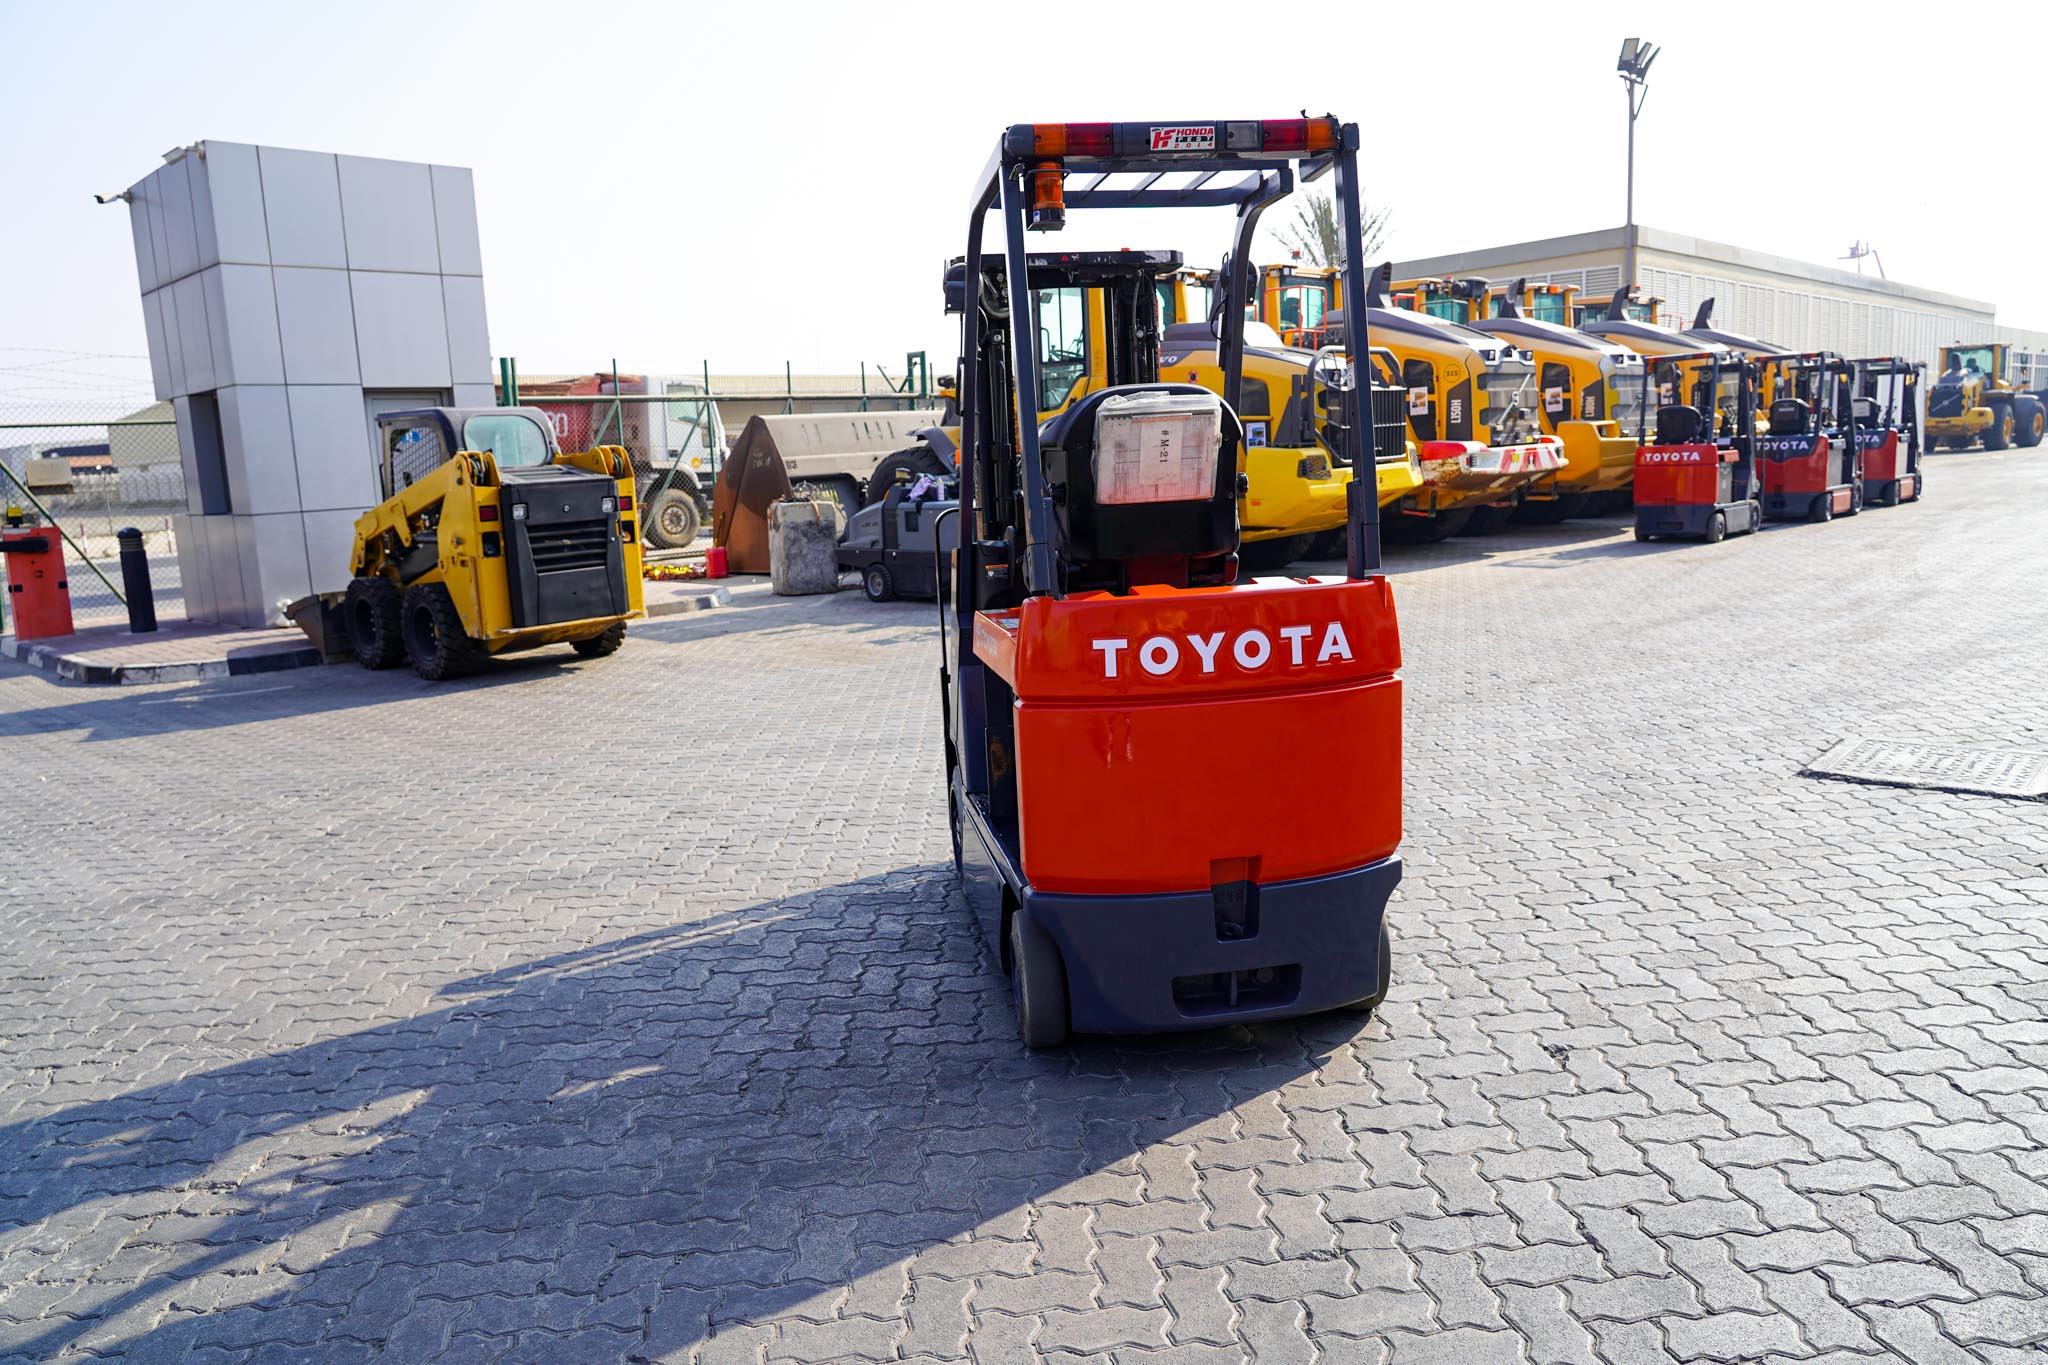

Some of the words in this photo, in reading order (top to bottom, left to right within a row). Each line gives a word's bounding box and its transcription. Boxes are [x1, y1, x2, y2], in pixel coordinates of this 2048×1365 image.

[1450, 399, 1461, 423] L150H
[1160, 439, 1169, 462] M-21
[1645, 452, 1700, 462] TOYOTA
[1755, 441, 1809, 450] TOYOTA
[1092, 622, 1354, 678] TOYOTA
